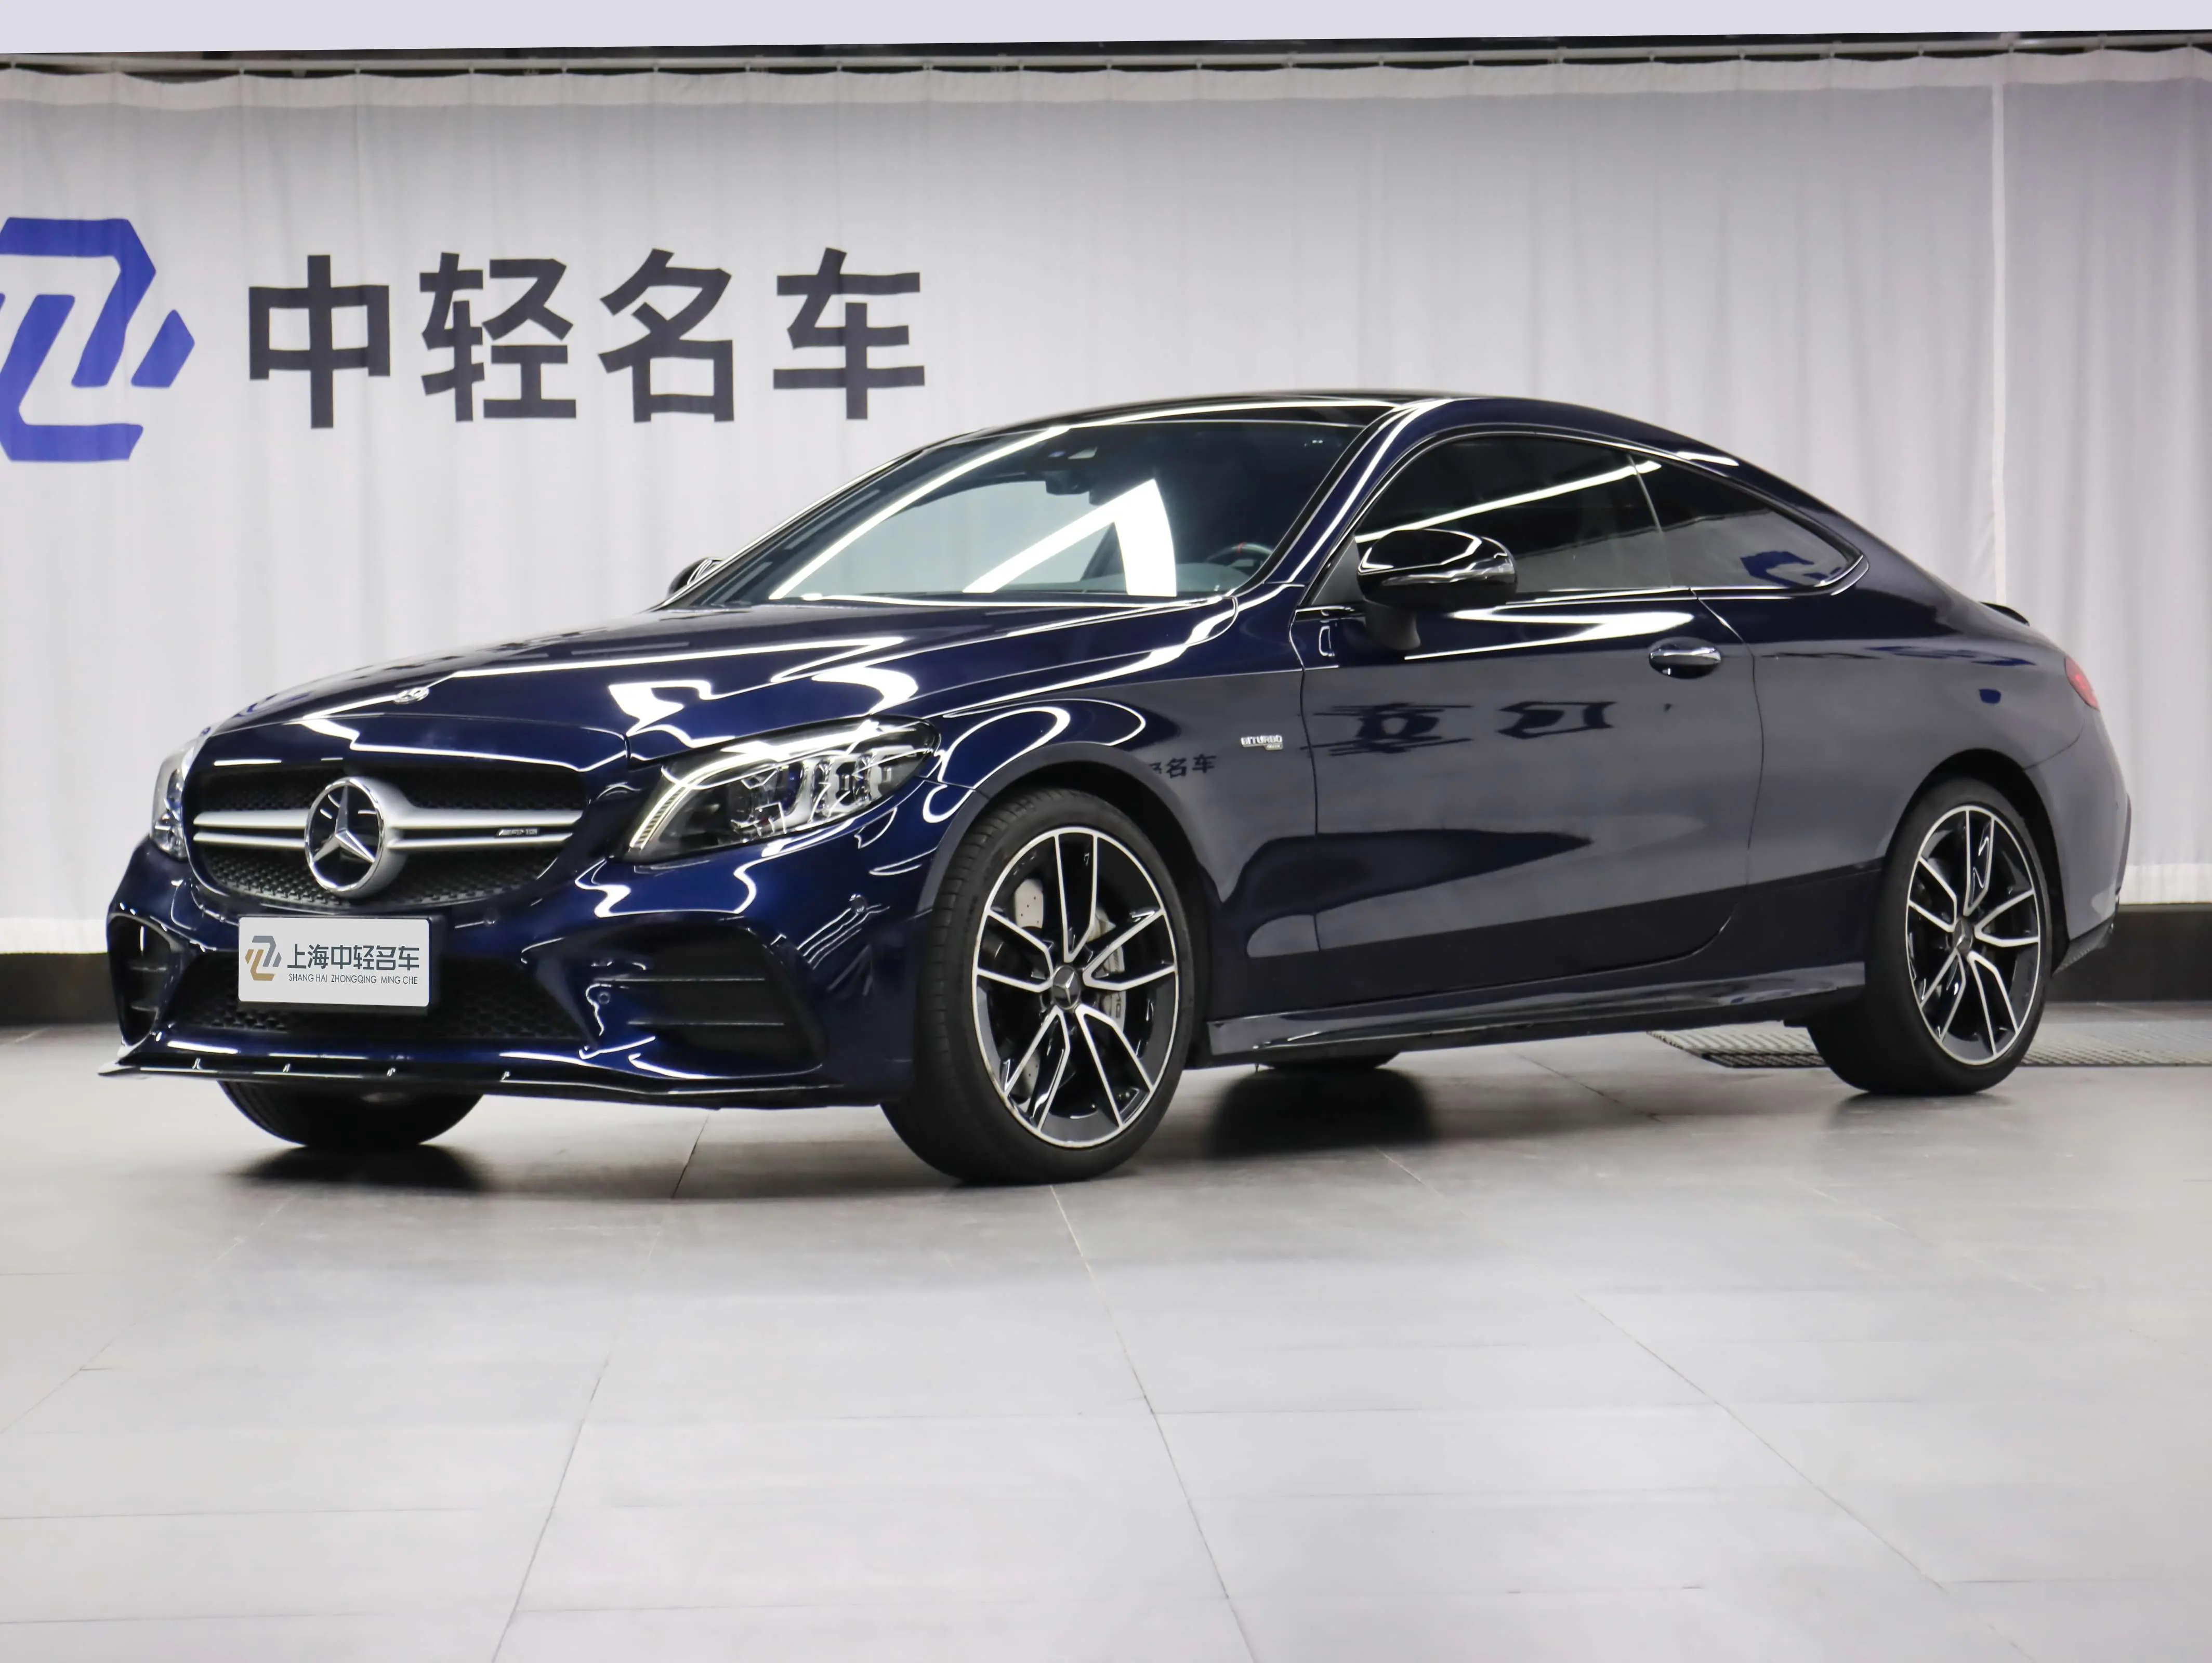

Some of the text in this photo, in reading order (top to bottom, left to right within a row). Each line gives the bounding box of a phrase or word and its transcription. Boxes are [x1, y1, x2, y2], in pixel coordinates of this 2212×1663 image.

[249, 248, 924, 428] 中轻名车
[287, 943, 419, 971] 上海中轻名车
[288, 973, 418, 985] SHANG HAI ZHONGQING MING CHE
